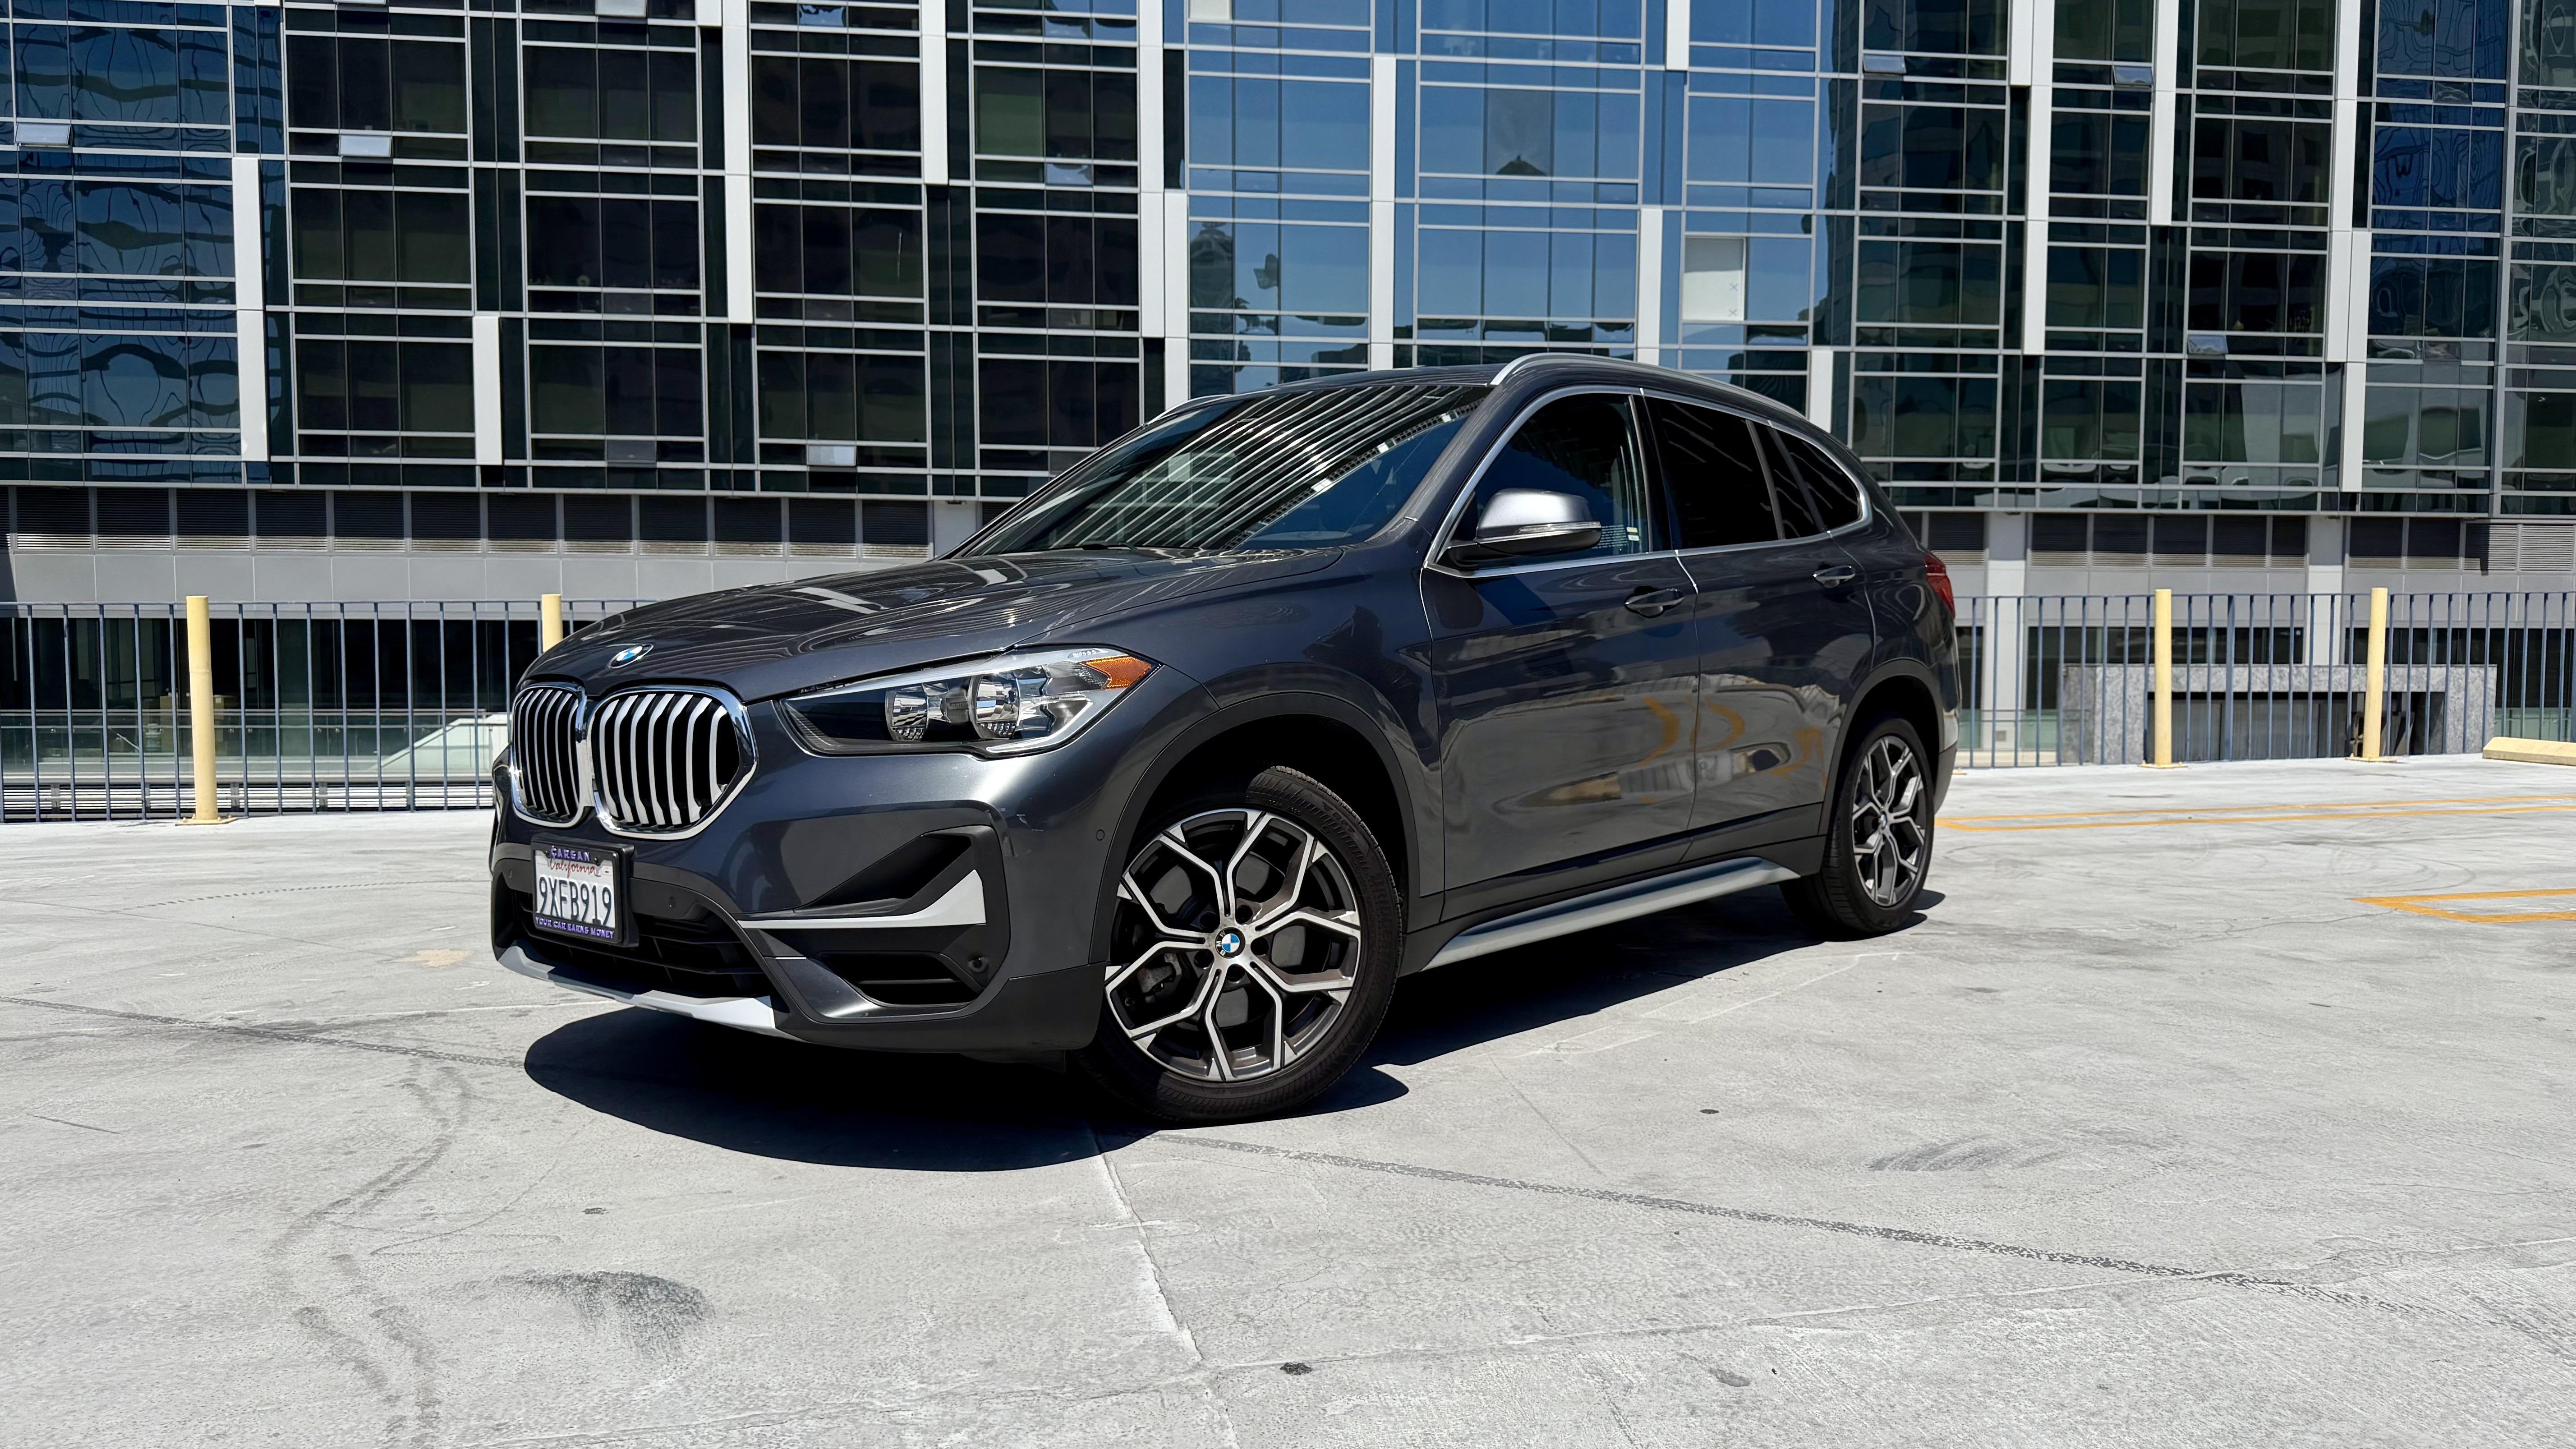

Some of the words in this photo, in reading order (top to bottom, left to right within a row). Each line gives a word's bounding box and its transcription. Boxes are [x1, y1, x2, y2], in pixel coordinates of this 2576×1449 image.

[539, 876, 612, 925] 9XFB919
[535, 916, 552, 927] YOUR
[553, 920, 566, 930] CAR
[567, 923, 589, 934] EARNS
[590, 928, 615, 939] MONEY
